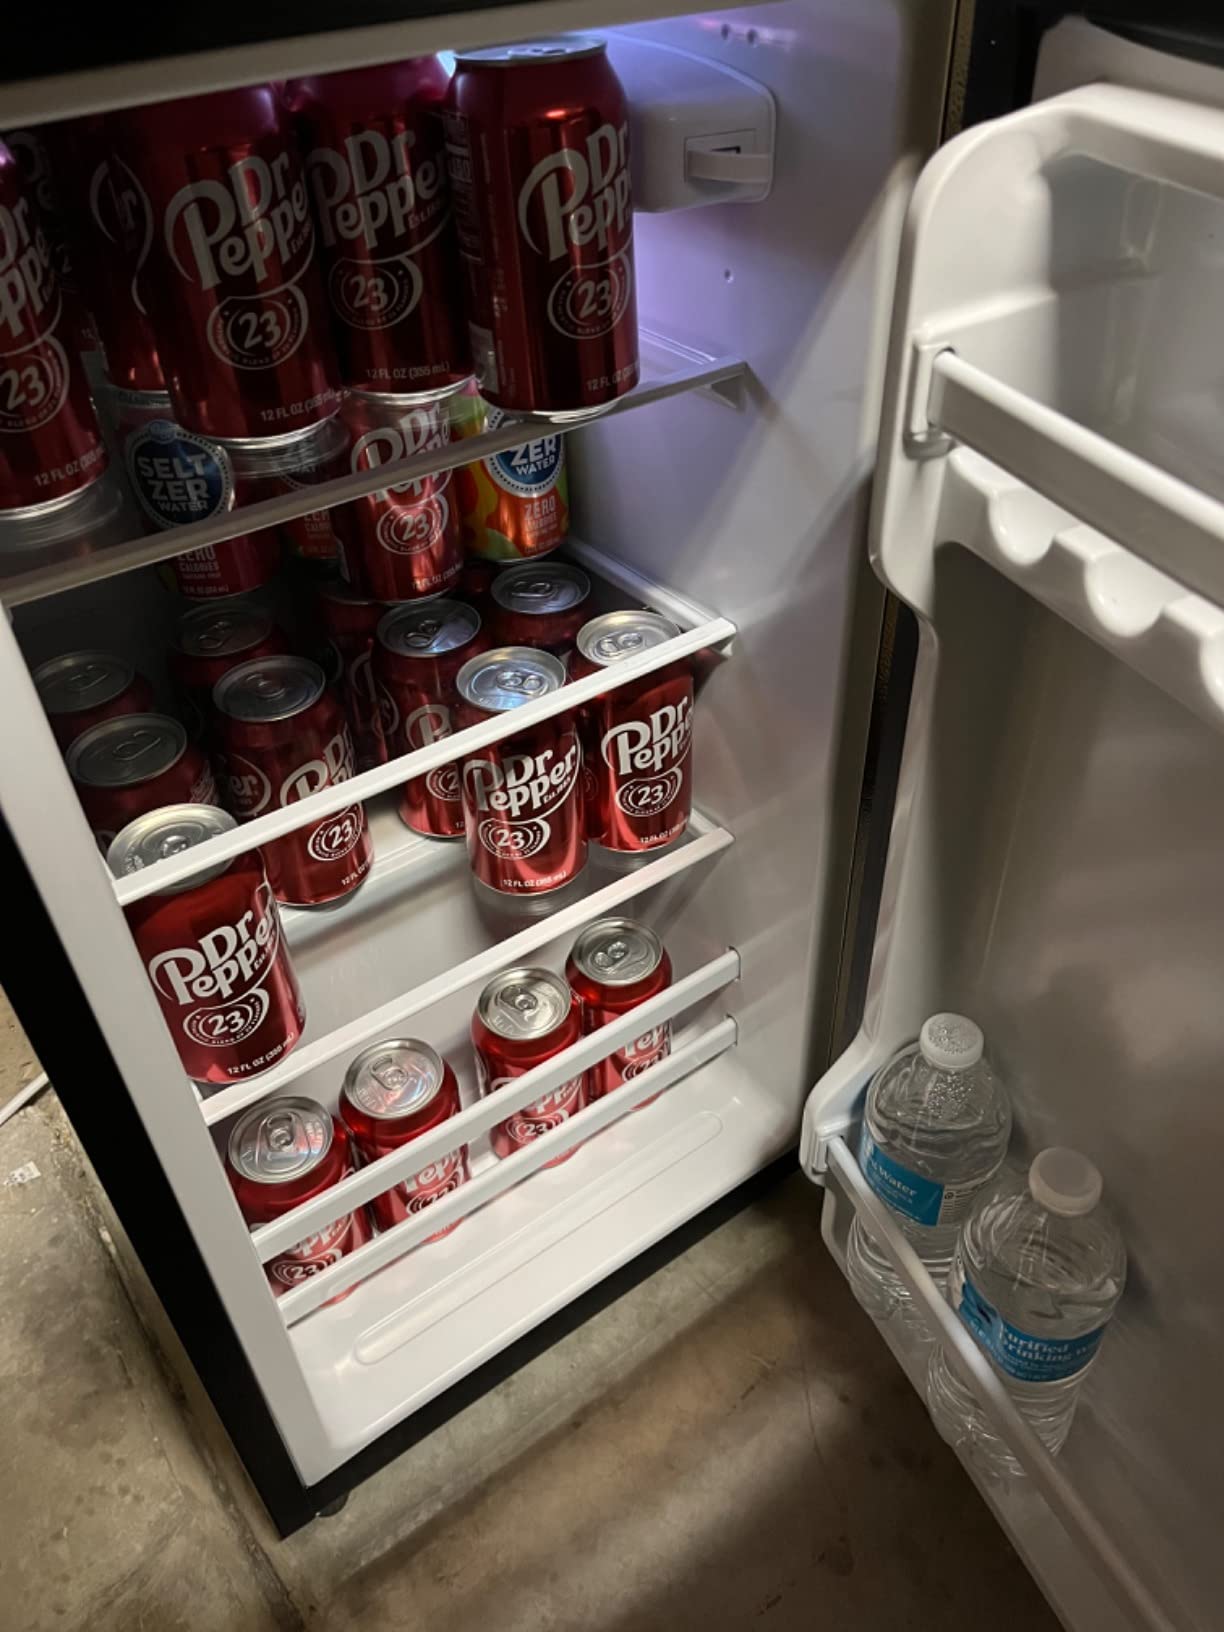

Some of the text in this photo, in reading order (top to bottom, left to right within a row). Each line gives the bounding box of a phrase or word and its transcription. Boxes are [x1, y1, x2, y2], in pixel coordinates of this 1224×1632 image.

[344, 129, 416, 196] Dr
[227, 153, 290, 227] Dr
[517, 147, 629, 263] Pepp
[163, 176, 309, 290] Peppe
[349, 275, 389, 311] 23
[577, 279, 611, 320] 23
[238, 311, 281, 350] 23
[0, 366, 46, 411] 23
[378, 367, 391, 380] FL
[392, 367, 408, 380] OZ
[260, 409, 275, 422] 12
[275, 406, 291, 420] FL
[290, 402, 304, 416] OZ
[398, 400, 441, 457] Dr
[137, 452, 207, 479] SELT
[510, 430, 557, 467] ZER
[515, 454, 556, 476] WATER
[34, 472, 51, 487] 12
[147, 479, 212, 502] ZER
[157, 499, 209, 513] WATER
[525, 495, 556, 519] ZERO
[400, 515, 430, 542] 23
[649, 695, 688, 744] Dr
[601, 707, 692, 777] Pepp
[463, 744, 576, 817] Pepper
[503, 749, 554, 788] Dr
[637, 784, 664, 806] 23
[328, 819, 353, 849] 23
[496, 828, 526, 850] 23
[198, 909, 254, 971] Dr
[207, 1010, 245, 1037] 23
[228, 1066, 240, 1076] 12
[240, 1063, 252, 1073] FL
